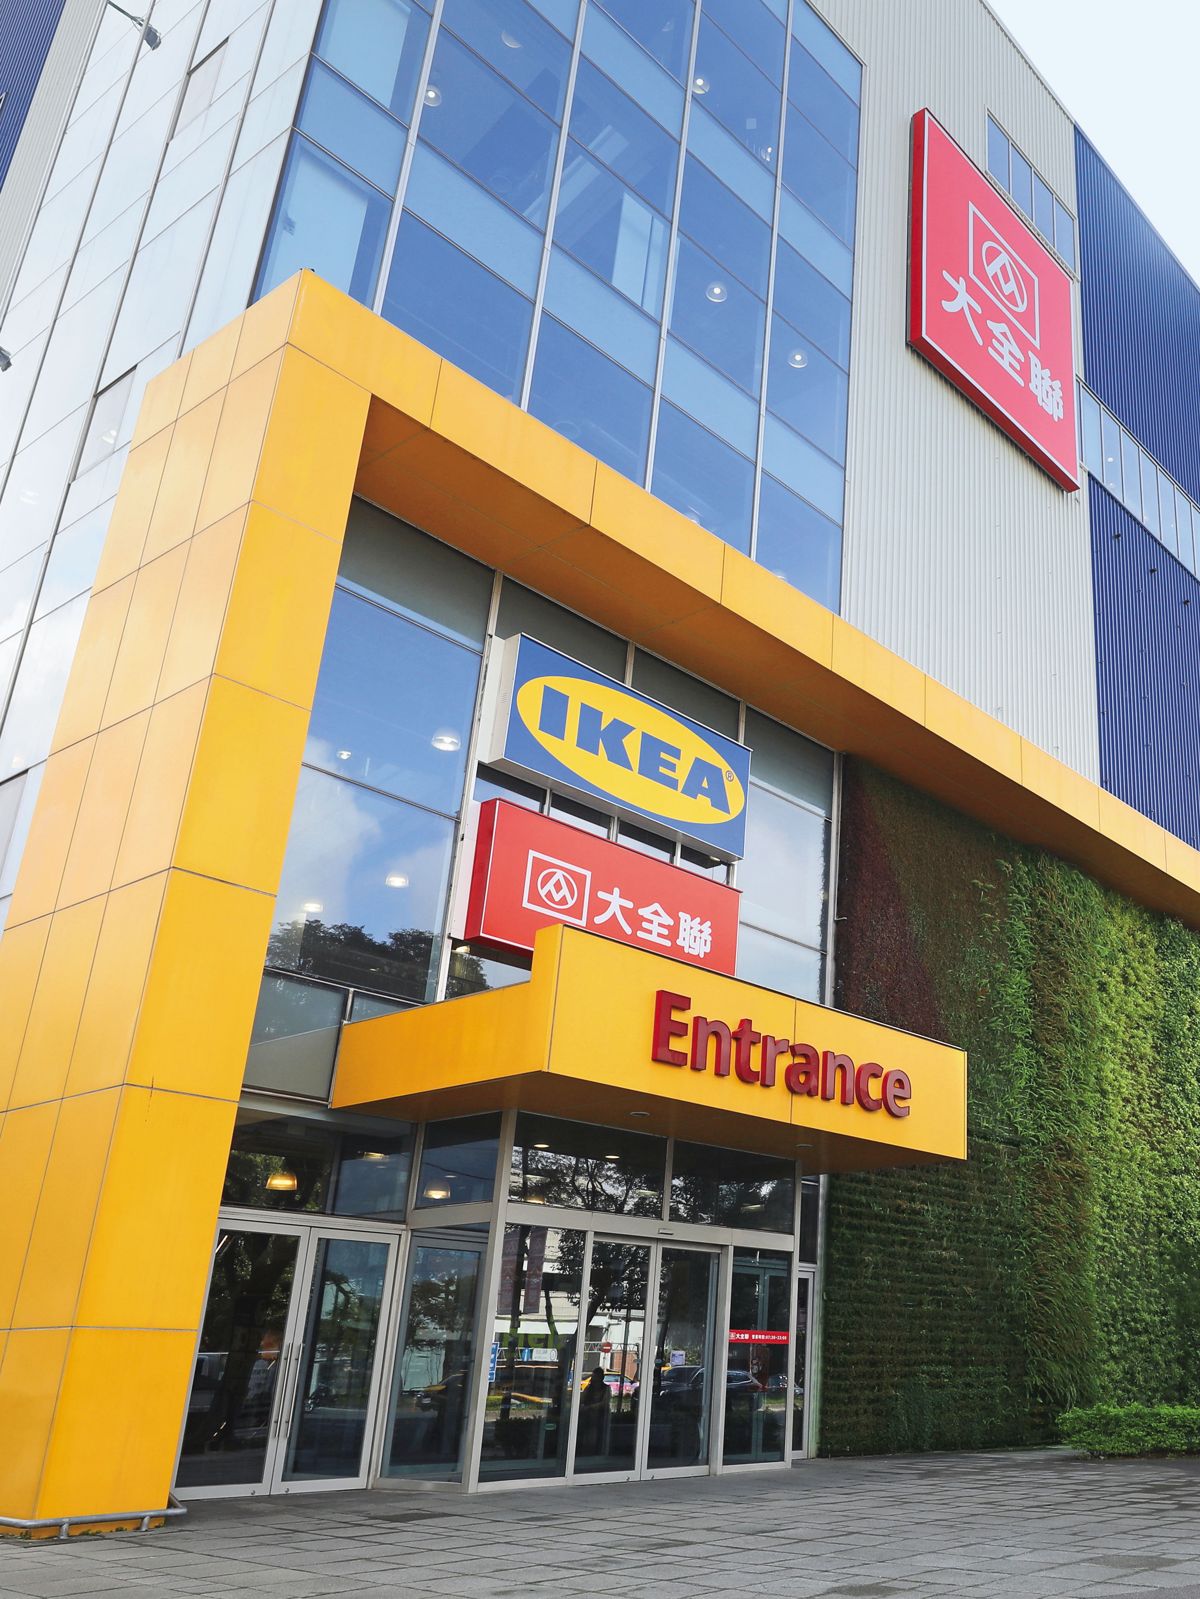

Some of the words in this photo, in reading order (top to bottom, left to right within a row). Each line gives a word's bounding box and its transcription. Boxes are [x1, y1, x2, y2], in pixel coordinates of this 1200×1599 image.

[941, 270, 1063, 421] 大全聯
[538, 685, 733, 815] IKEA
[594, 887, 712, 959] 大全聯
[652, 989, 912, 1119] Entrance
